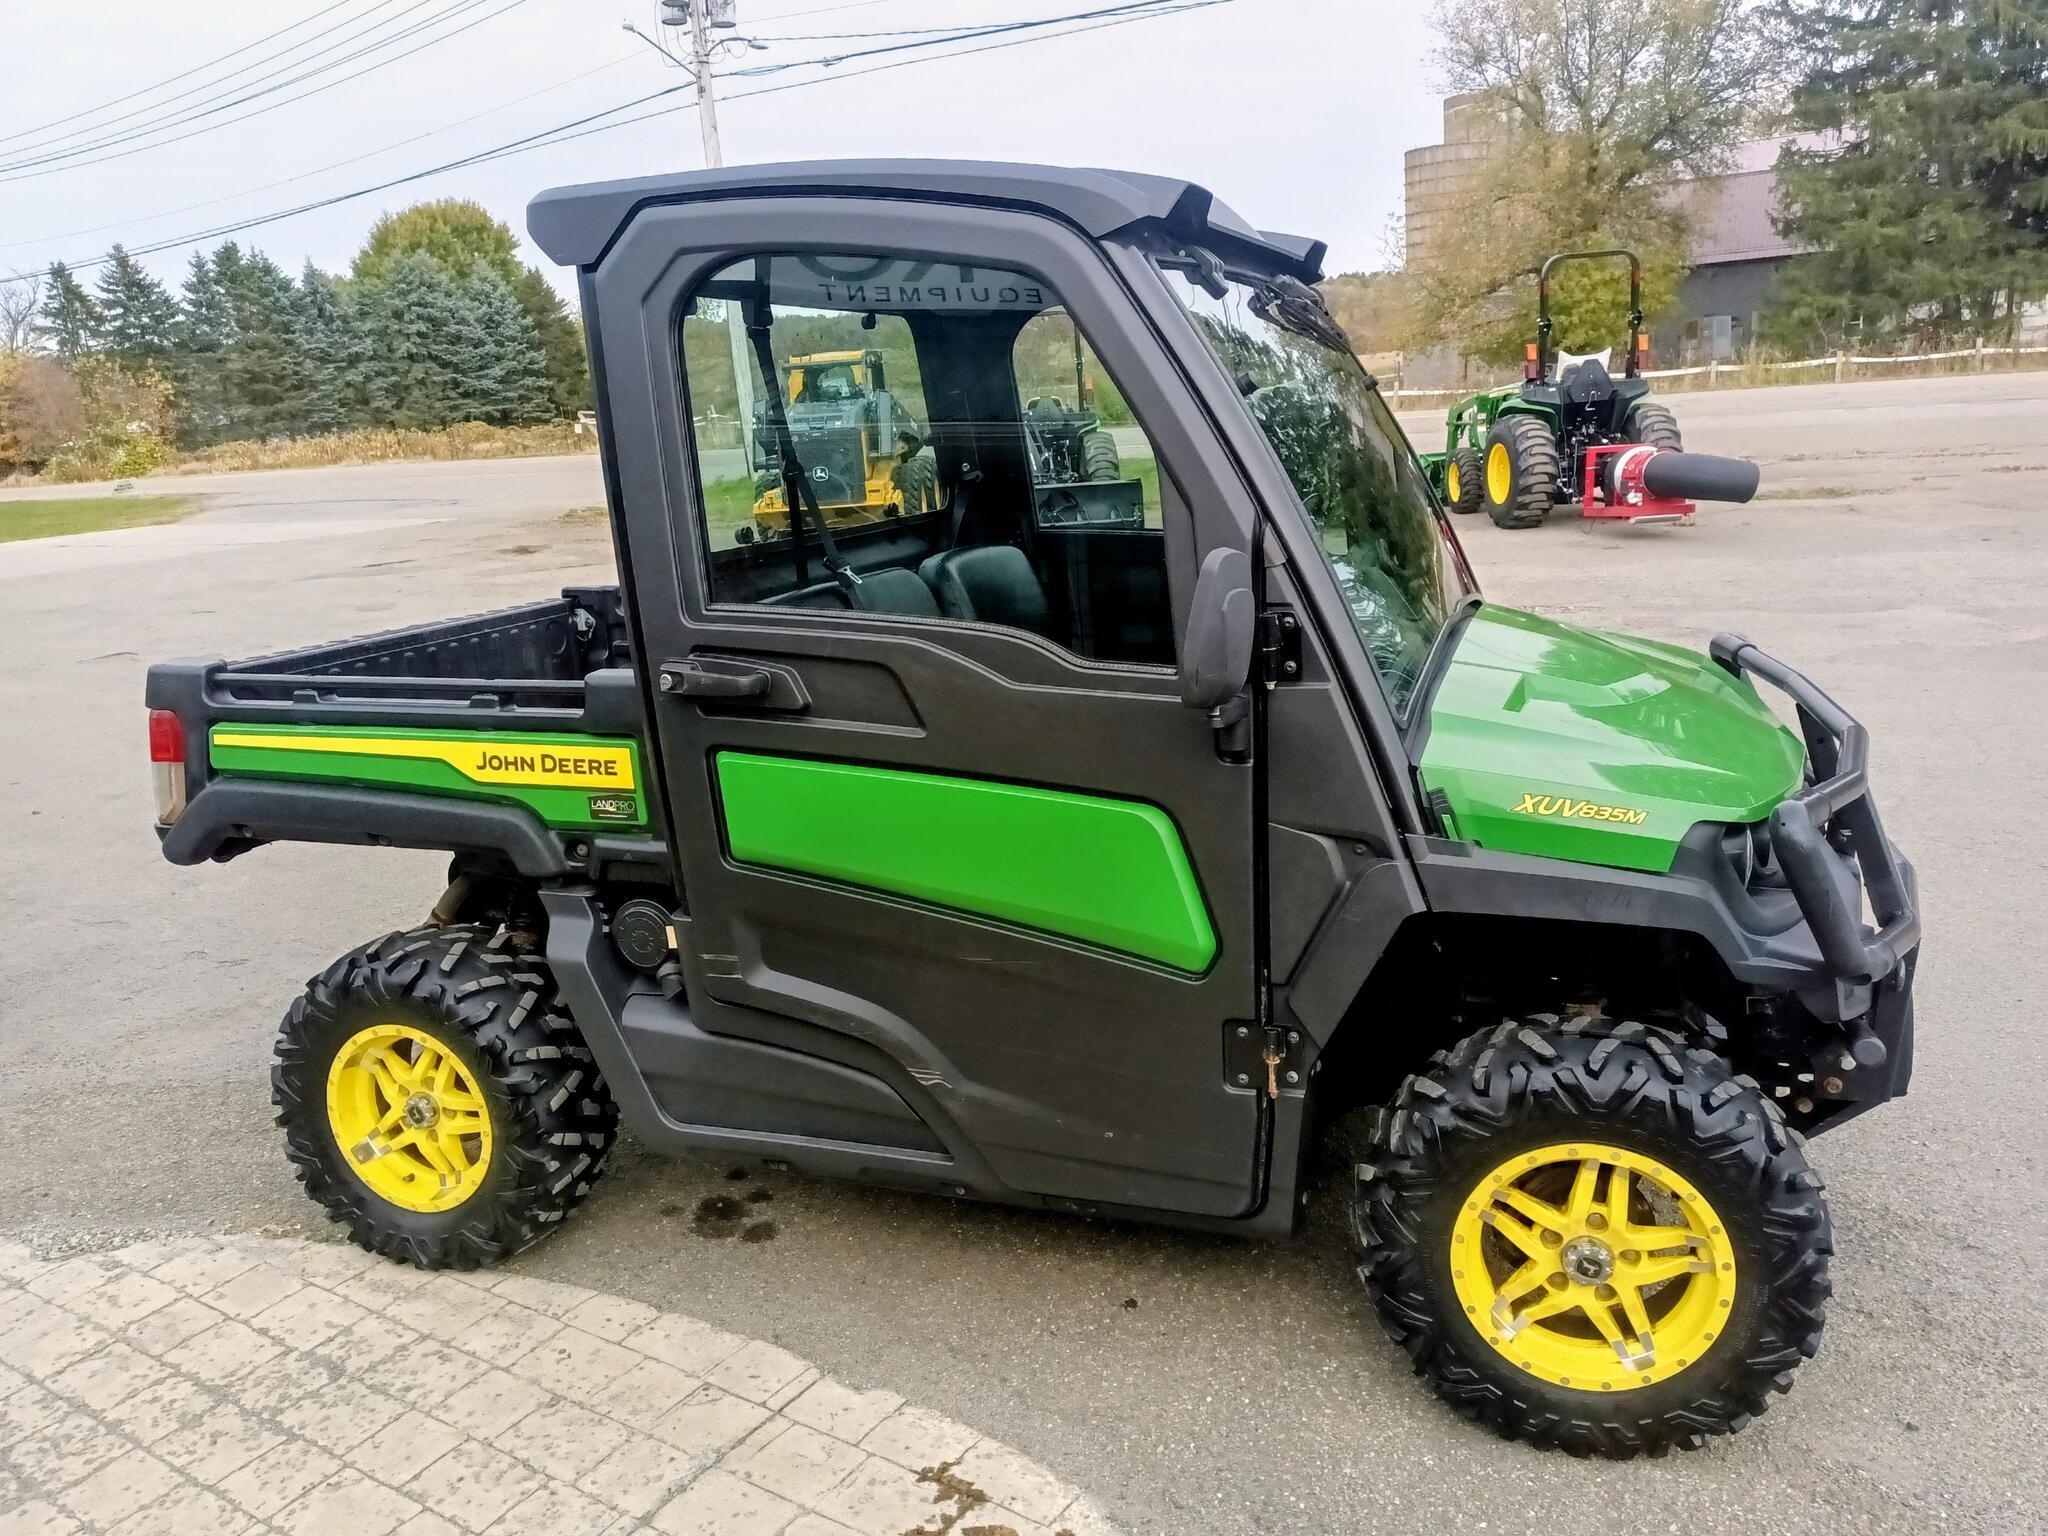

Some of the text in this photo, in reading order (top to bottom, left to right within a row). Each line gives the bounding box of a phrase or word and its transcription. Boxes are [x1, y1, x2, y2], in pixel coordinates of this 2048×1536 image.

[476, 752, 617, 776] JOHN DEERE
[1513, 793, 1649, 825] XUV835M
